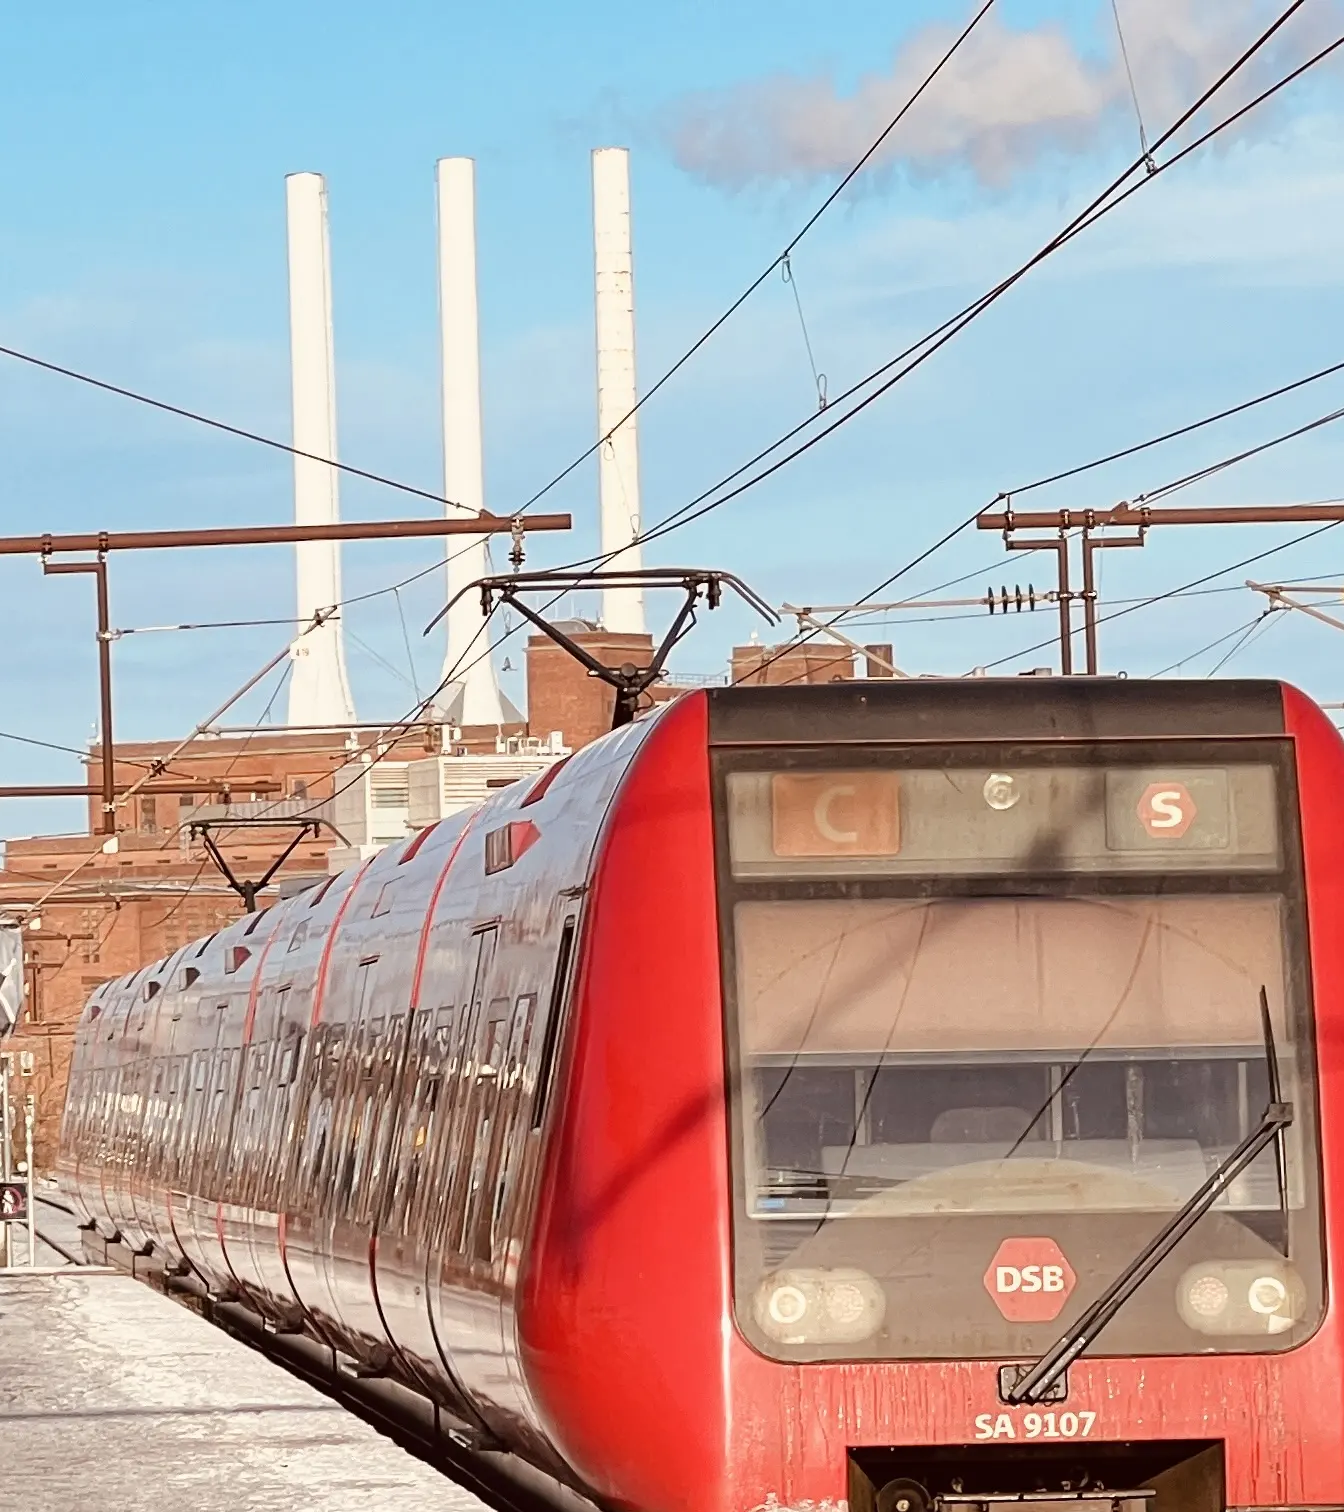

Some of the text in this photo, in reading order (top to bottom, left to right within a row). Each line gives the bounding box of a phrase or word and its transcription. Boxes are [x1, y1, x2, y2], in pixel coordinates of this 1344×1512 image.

[814, 785, 858, 842] C
[1151, 791, 1182, 827] S
[996, 1266, 1065, 1292] DSB
[975, 1411, 1096, 1439] SA 9107
